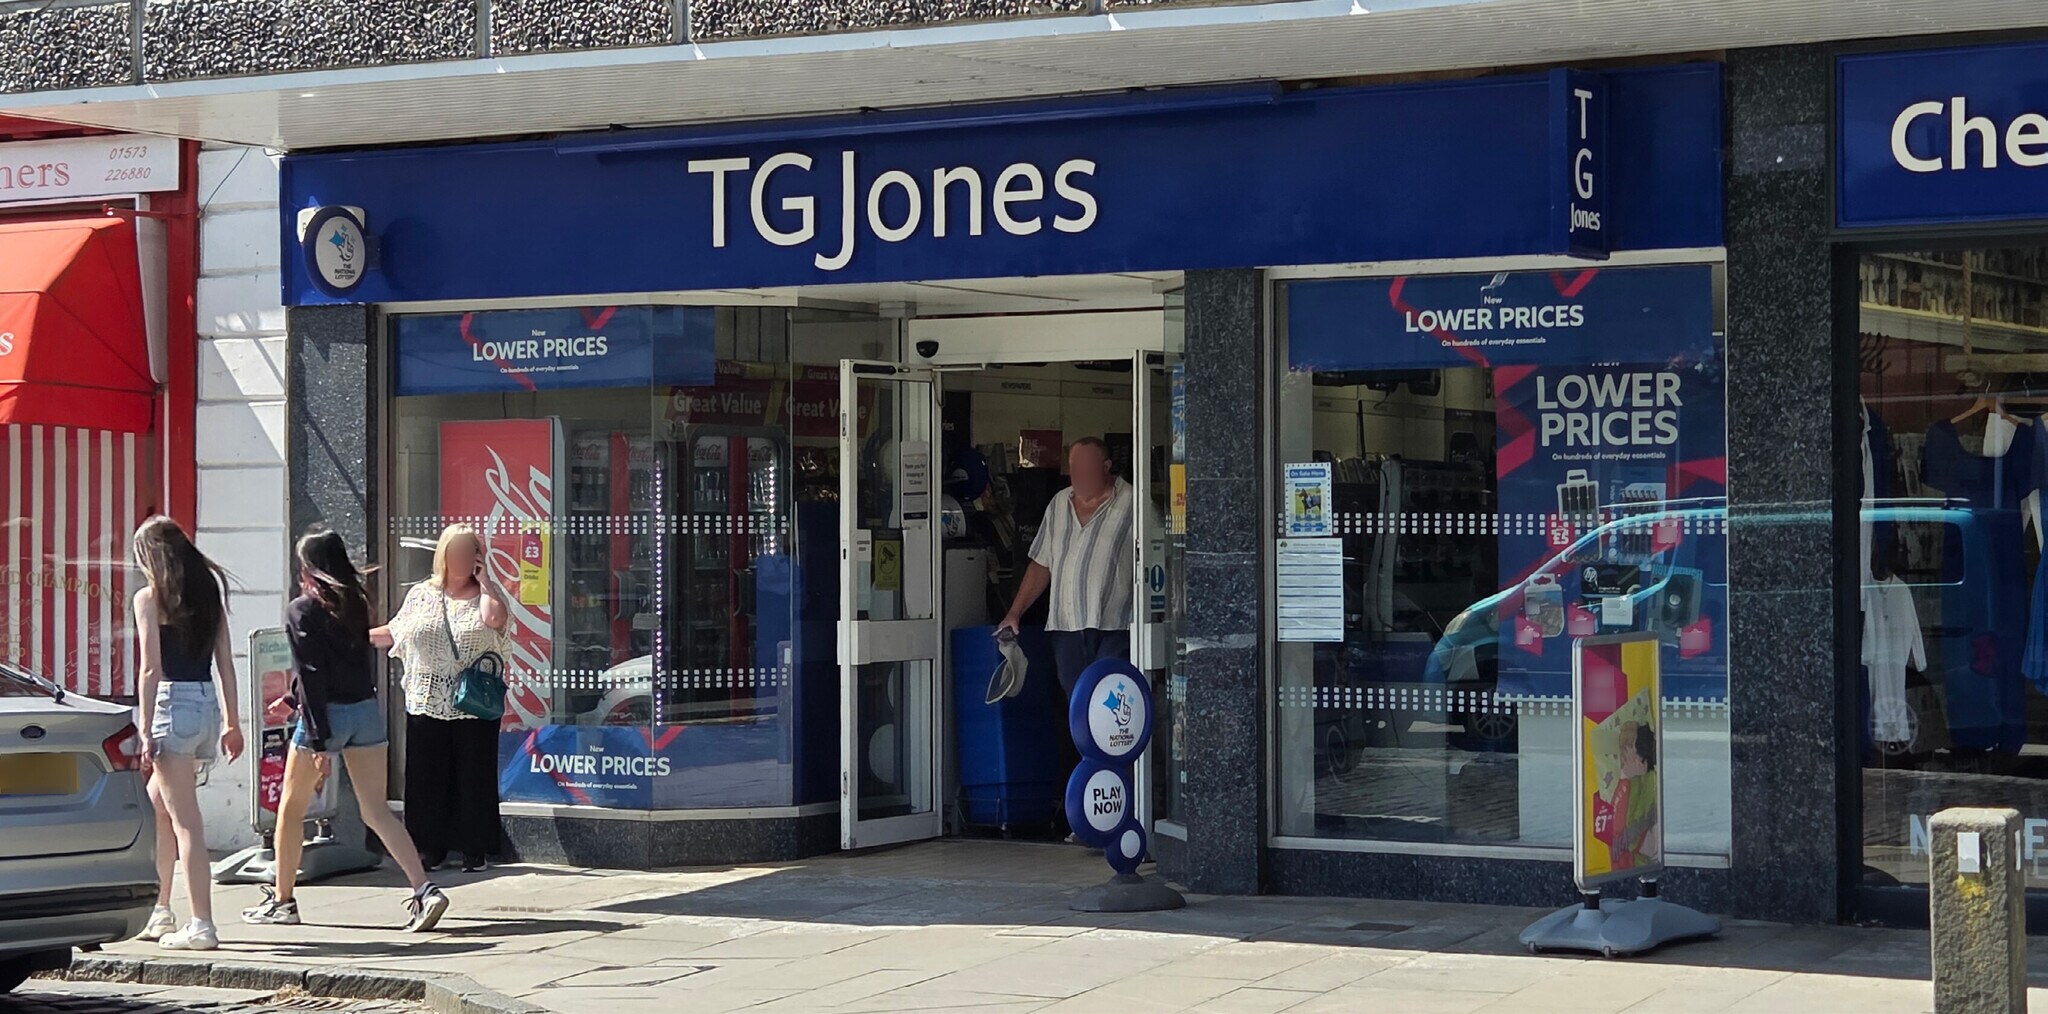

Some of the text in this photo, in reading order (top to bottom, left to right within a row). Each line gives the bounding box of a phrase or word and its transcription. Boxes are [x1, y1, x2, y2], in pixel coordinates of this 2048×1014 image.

[1574, 88, 1593, 139] T
[1891, 97, 2048, 172] Che
[109, 146, 147, 160] 01573
[105, 167, 151, 181] 226880
[1574, 148, 1593, 199] G
[1569, 202, 1601, 233] Jones
[1484, 296, 1503, 304] New
[1405, 305, 1585, 333] LOWER PRICES
[473, 336, 608, 361] LOWER PRICES
[1442, 339, 1451, 347] On
[1452, 338, 1480, 346] hundreds
[1481, 338, 1488, 346] of
[1488, 338, 1515, 346] everyday
[1536, 372, 1683, 409] LOWER
[674, 392, 762, 414] Great Value
[785, 398, 826, 418] Great
[1541, 410, 1678, 447] PRICES
[1563, 452, 1592, 460] hundreds
[1594, 452, 1600, 460] of
[1602, 452, 1630, 461] everyday
[525, 546, 540, 558] £3
[530, 754, 671, 776] LOWER PRICES
[1093, 786, 1121, 801] PLAY
[1093, 800, 1122, 815] NOW
